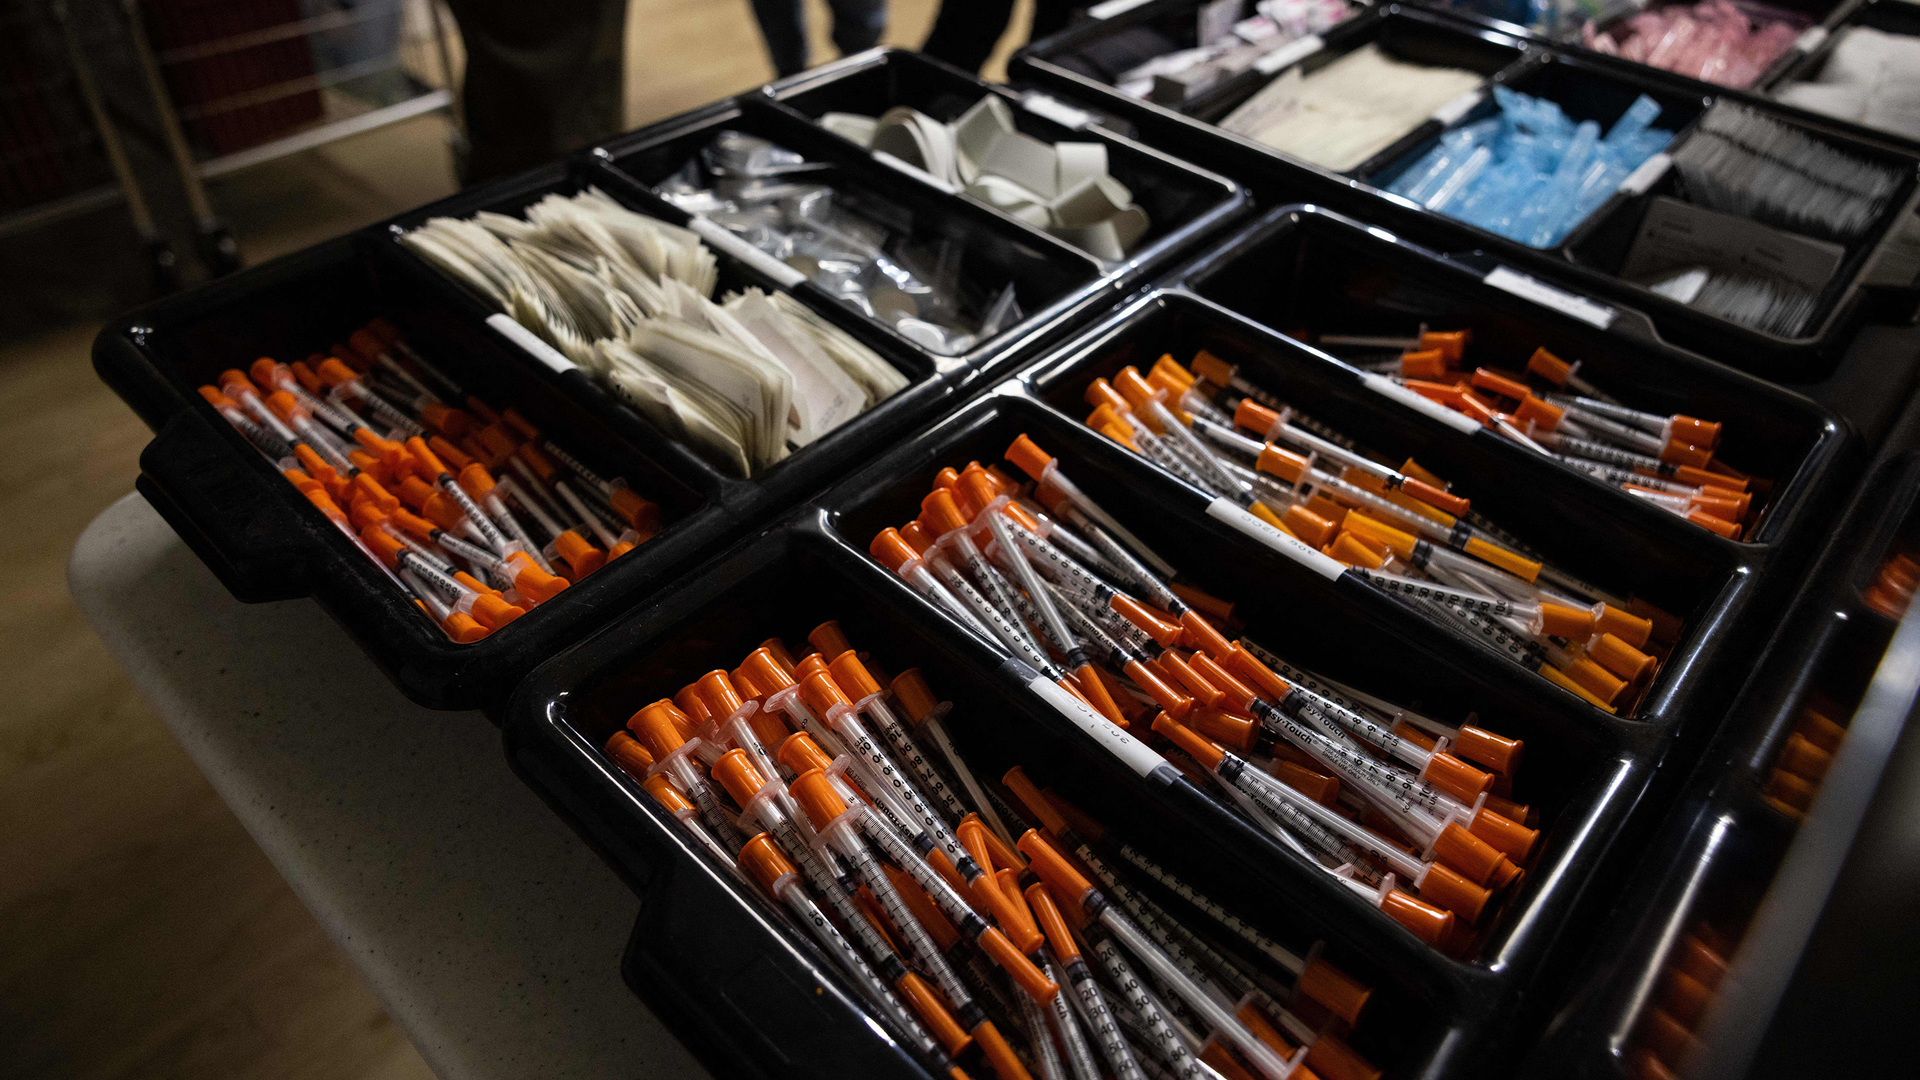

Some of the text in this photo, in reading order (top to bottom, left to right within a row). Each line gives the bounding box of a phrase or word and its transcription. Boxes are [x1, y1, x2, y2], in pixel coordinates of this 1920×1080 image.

[1262, 705, 1312, 745] asy·Touch
[899, 742, 912, 756] 90
[910, 756, 923, 769] 80
[920, 768, 934, 782] 70
[931, 782, 944, 795] 60
[942, 795, 956, 809] 50
[1100, 947, 1116, 963] 20
[1112, 963, 1127, 978] 30
[1081, 987, 1097, 1001] 20
[1124, 979, 1138, 994] 40
[1135, 995, 1150, 1011] 50
[1090, 1004, 1106, 1019] 30
[1147, 1012, 1162, 1027] 60
[1100, 1021, 1115, 1035] 40
[1158, 1028, 1175, 1045] 70
[1109, 1040, 1125, 1055] 50
[1170, 1046, 1187, 1062] 80
[1118, 1059, 1134, 1073] 60
